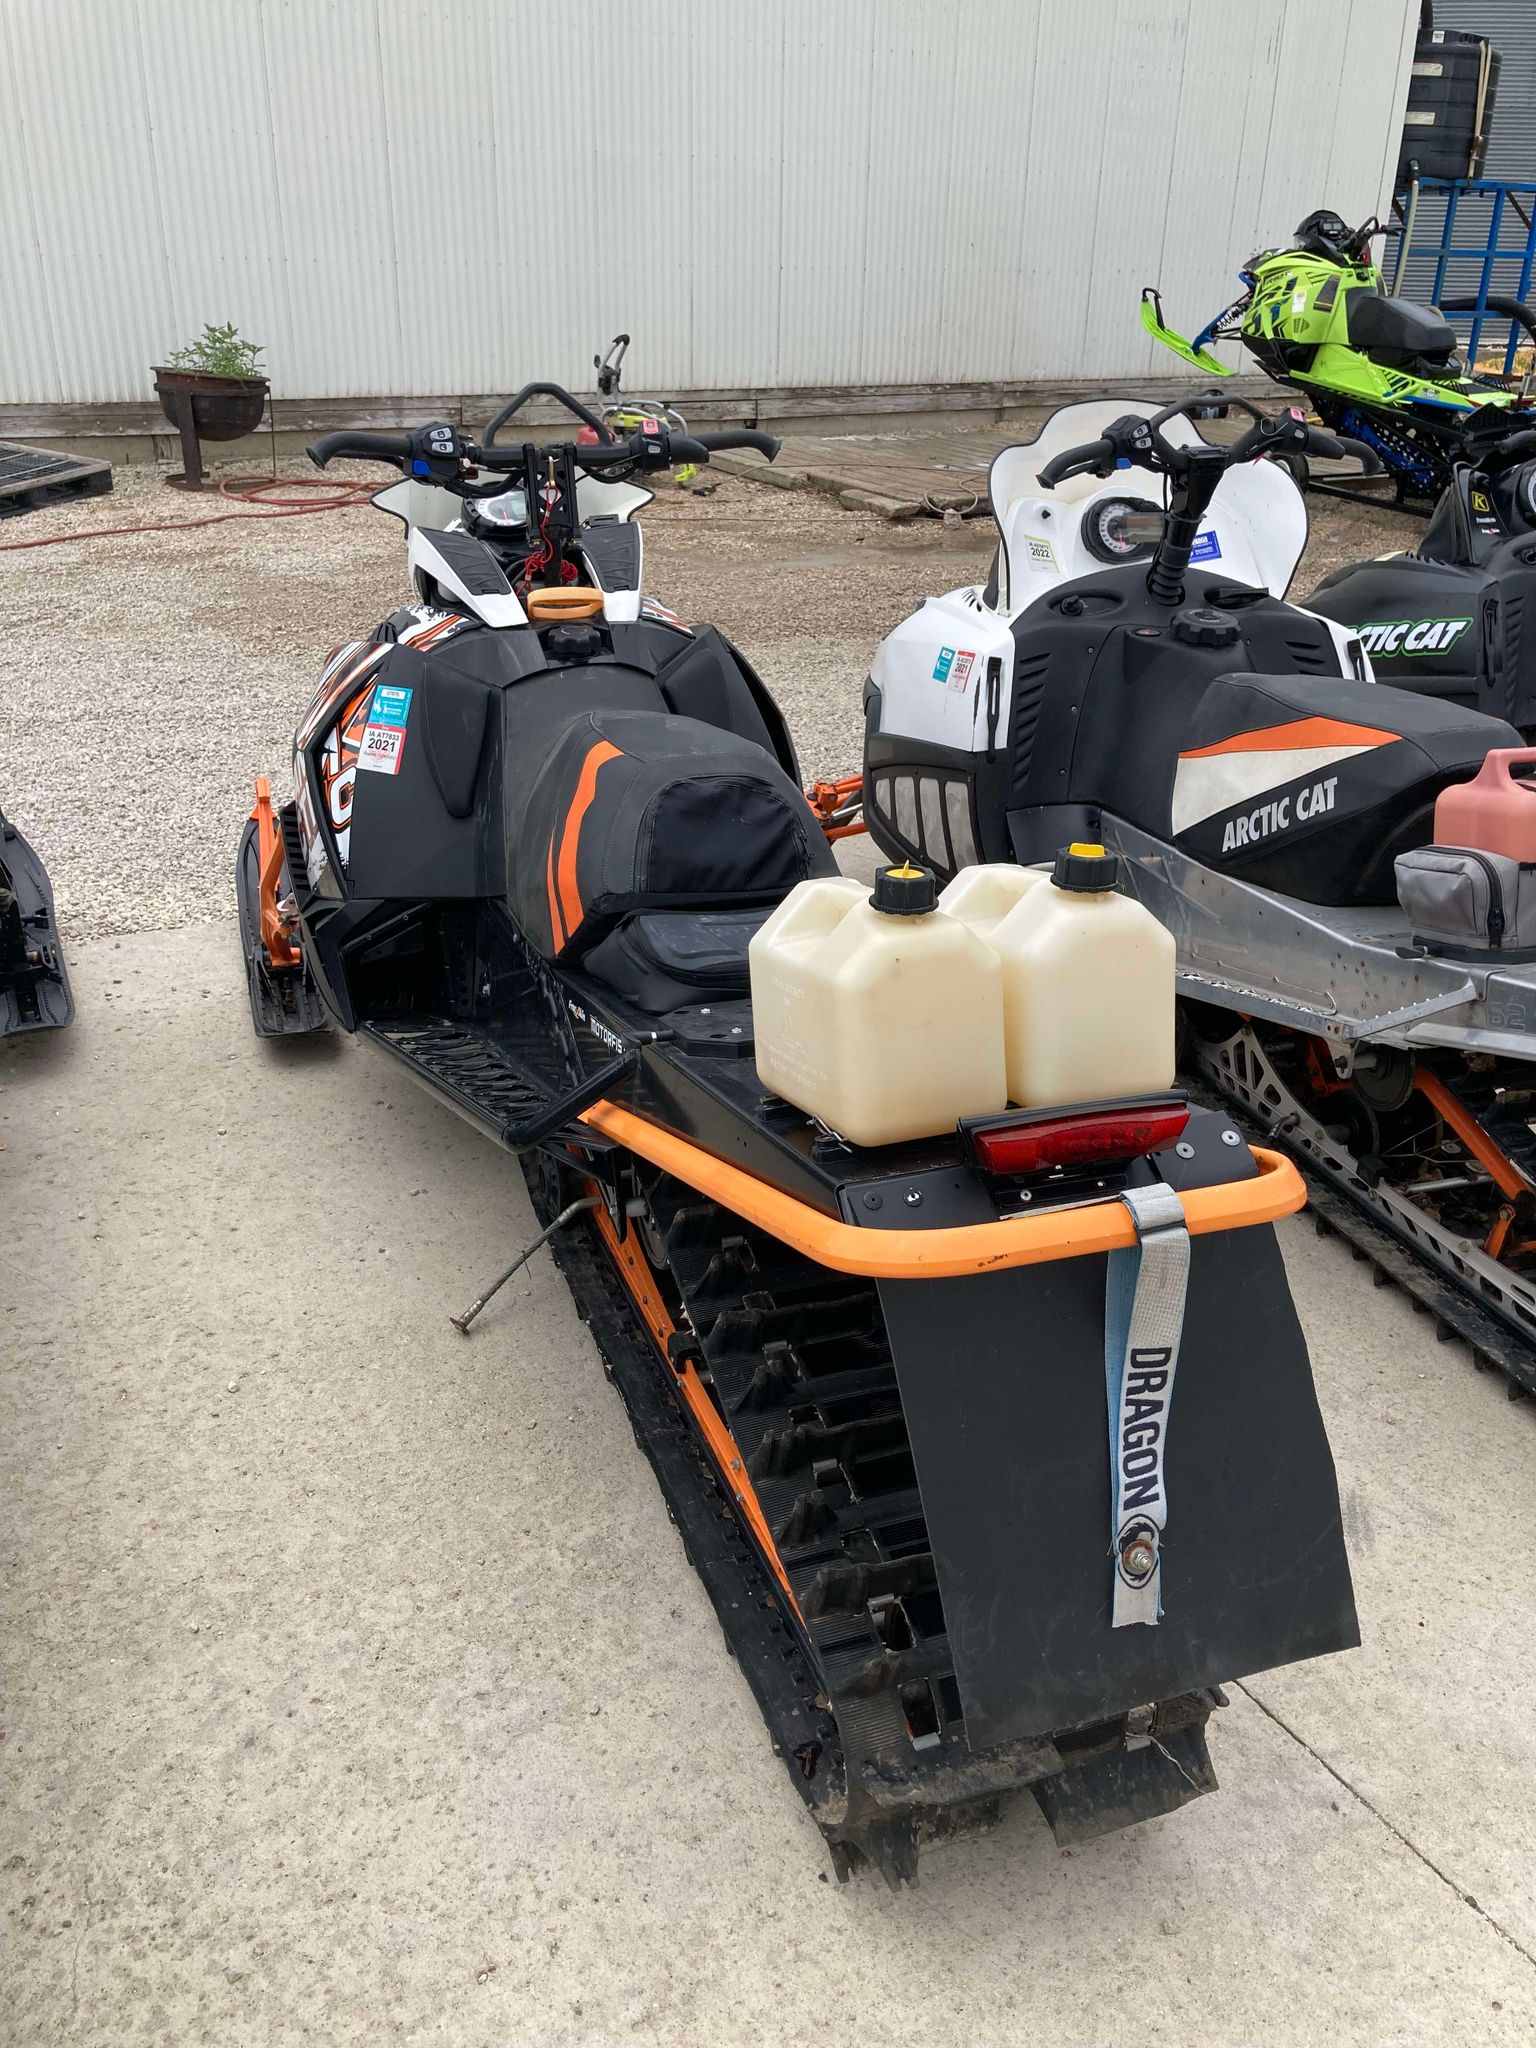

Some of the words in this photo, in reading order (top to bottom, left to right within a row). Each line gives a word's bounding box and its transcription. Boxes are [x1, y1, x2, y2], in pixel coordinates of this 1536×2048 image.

[1031, 547, 1050, 558] 2022
[1404, 621, 1467, 650] CAT
[954, 662, 969, 674] 2021
[367, 737, 396, 753] 2021
[1221, 796, 1290, 853] ARCTIC
[1296, 776, 1338, 821] CAT
[590, 1016, 625, 1054] MOTORFIS
[1122, 1346, 1172, 1511] DRAGON
